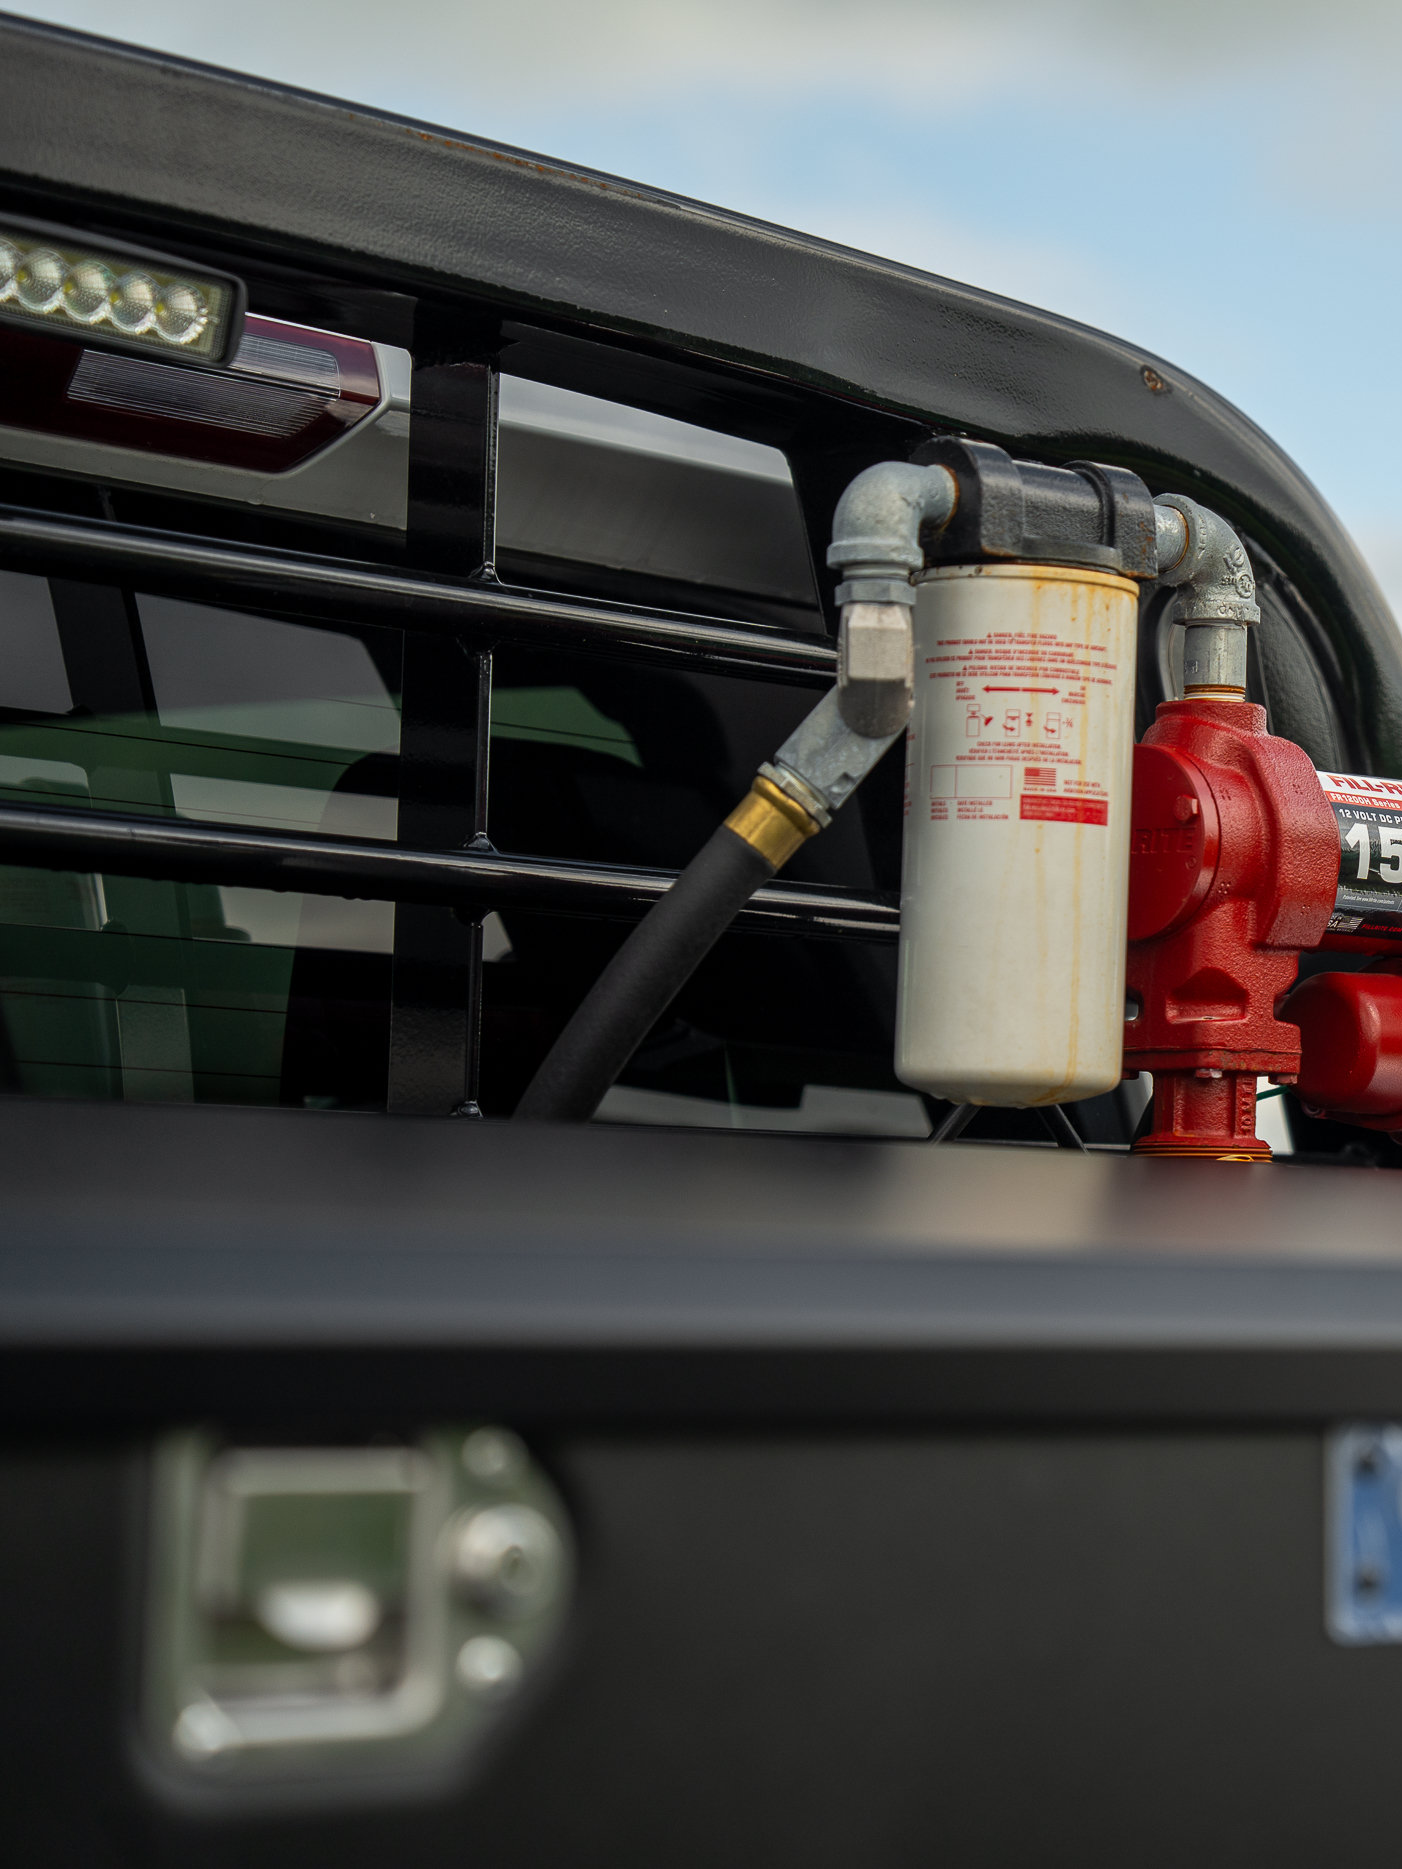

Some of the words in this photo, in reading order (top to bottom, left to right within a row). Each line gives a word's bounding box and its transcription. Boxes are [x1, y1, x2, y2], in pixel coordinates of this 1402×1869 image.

[1330, 793, 1371, 805] FR1200H
[1371, 798, 1400, 808] Series
[1339, 808, 1352, 818] 12
[1353, 810, 1377, 821] VOLT
[1379, 814, 1393, 823] DC
